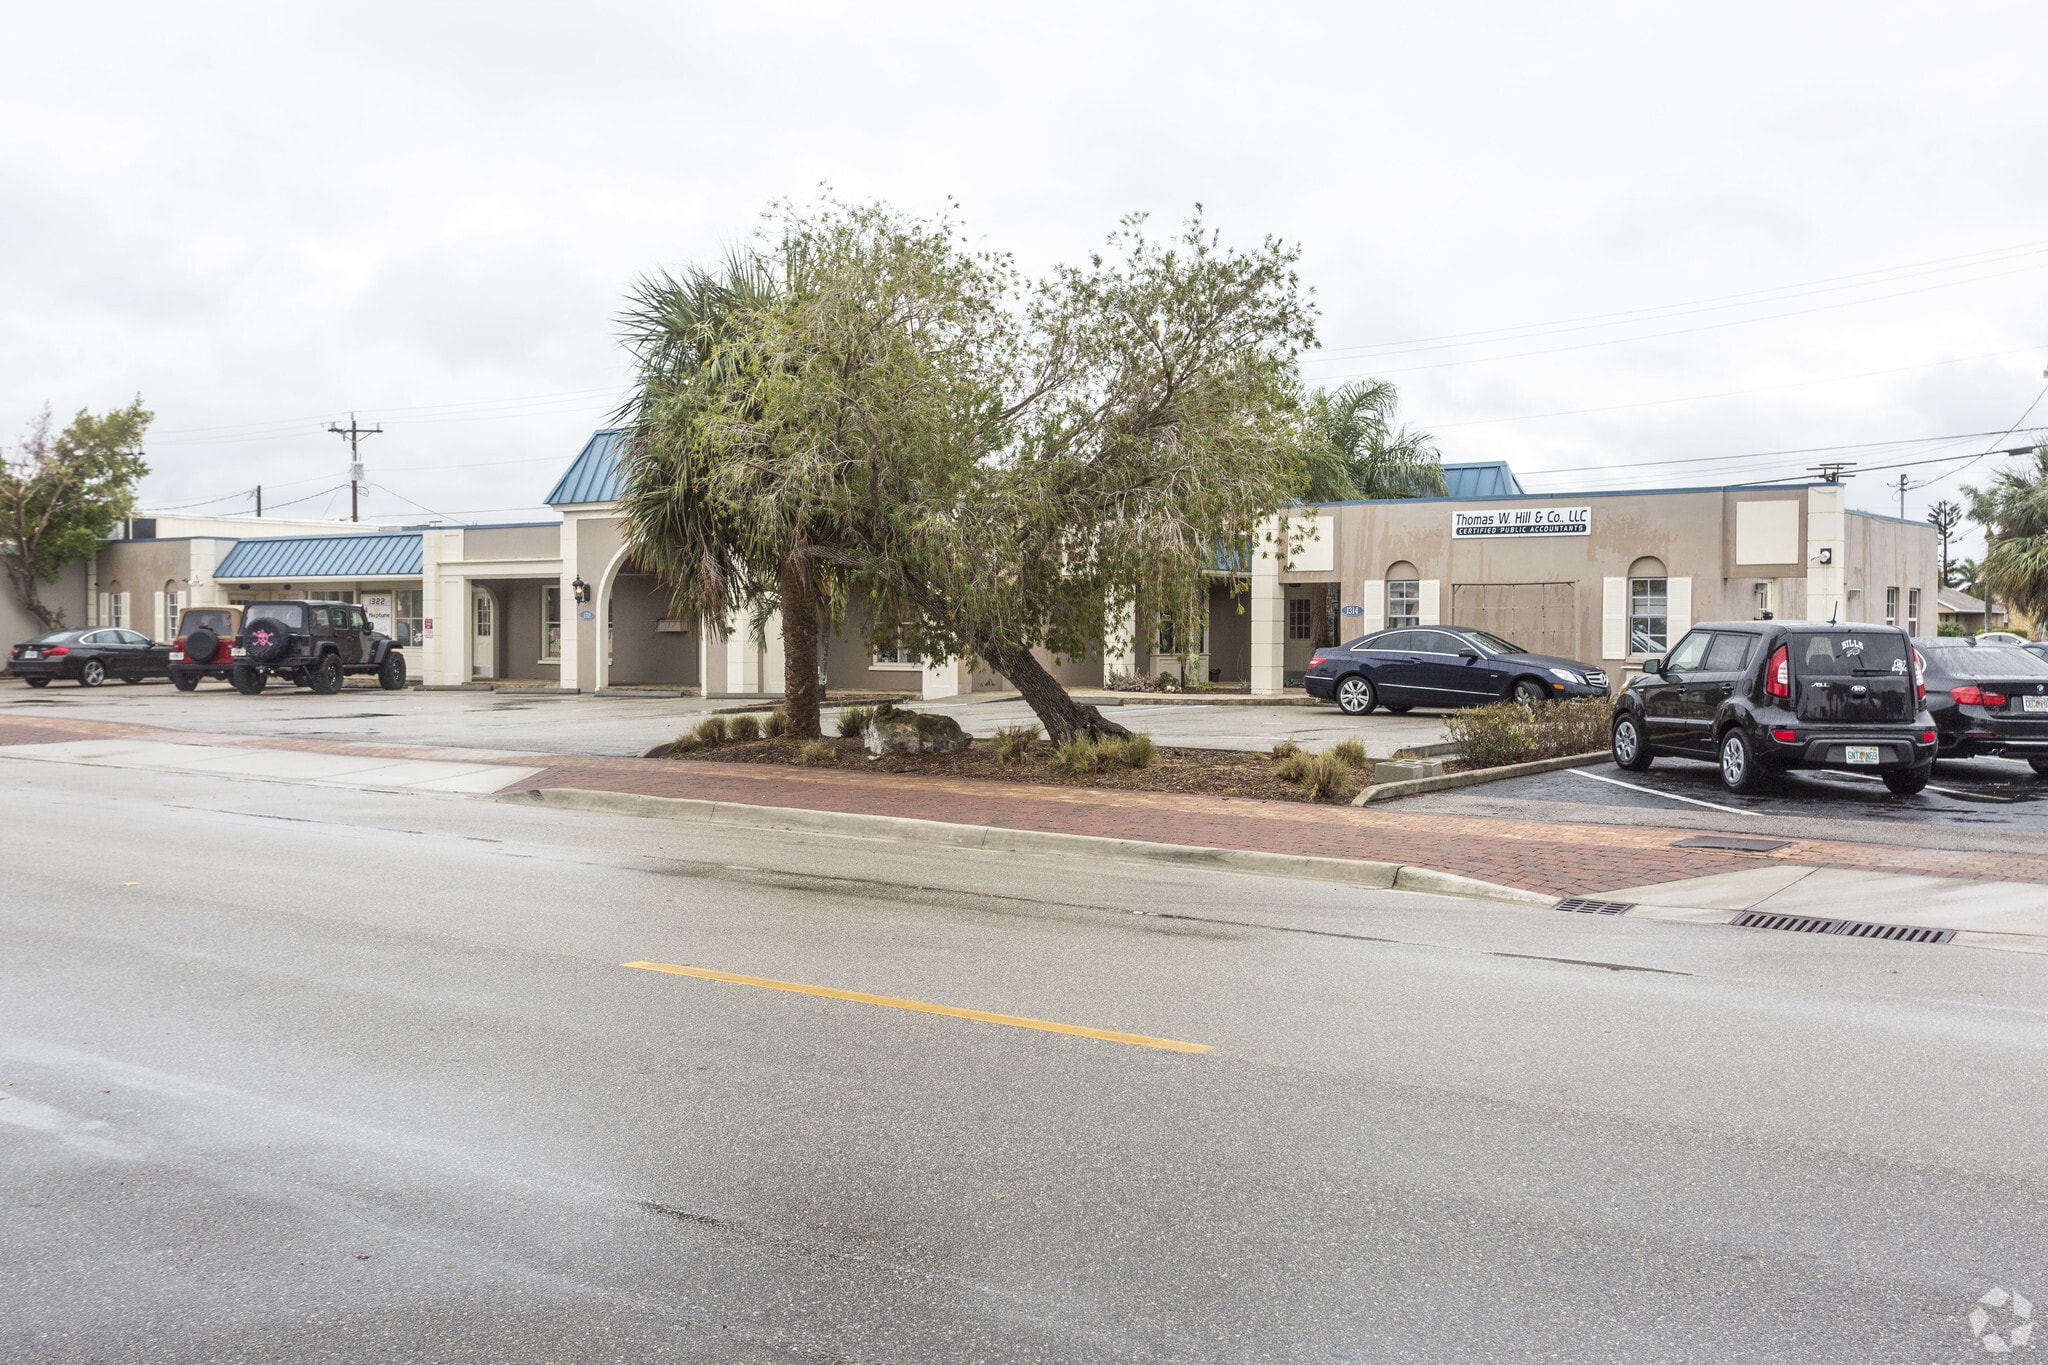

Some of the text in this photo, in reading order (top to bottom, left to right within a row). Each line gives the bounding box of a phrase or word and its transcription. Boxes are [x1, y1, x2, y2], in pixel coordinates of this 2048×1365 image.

[1456, 513, 1494, 526] Thomas
[1498, 511, 1511, 525] W.
[1514, 511, 1531, 524] Hill
[1534, 511, 1543, 524] &
[1569, 509, 1587, 522] LLC
[1458, 524, 1584, 535] CERTIFIED PUBLIC ACCOUNTANTS
[368, 597, 385, 605] 1322
[1346, 606, 1359, 615] 1314
[1841, 639, 1864, 650] BILLS
